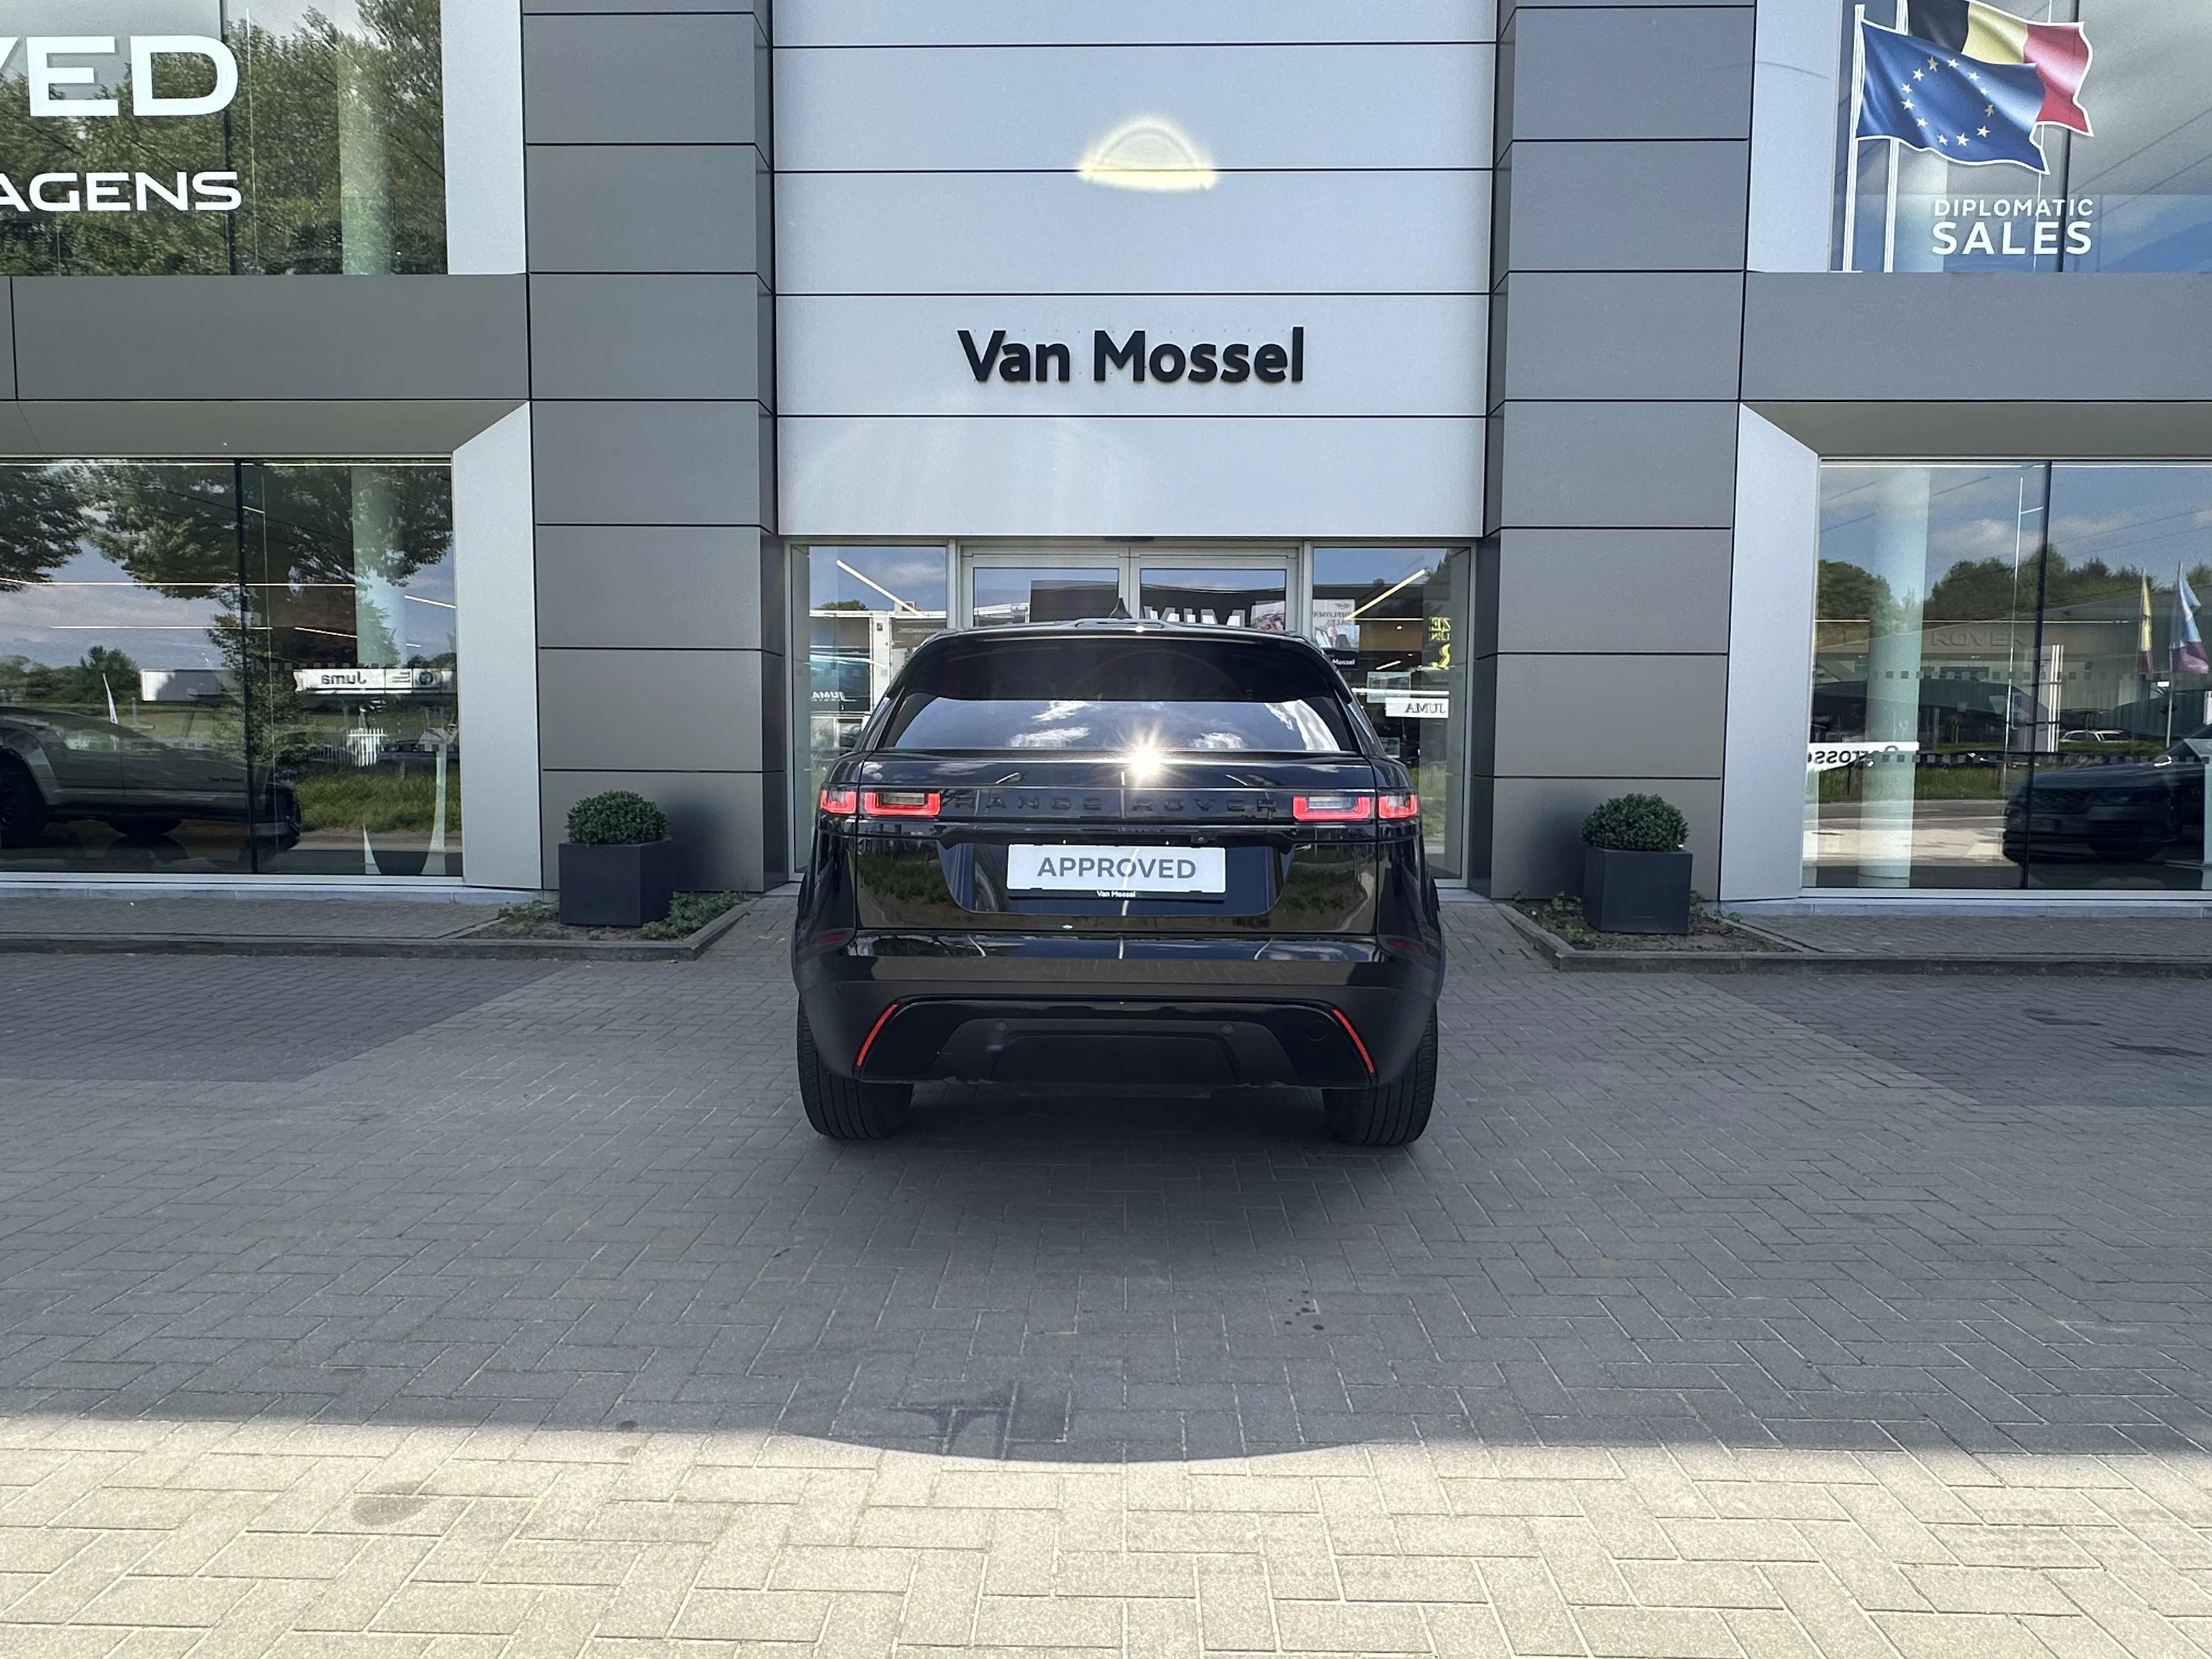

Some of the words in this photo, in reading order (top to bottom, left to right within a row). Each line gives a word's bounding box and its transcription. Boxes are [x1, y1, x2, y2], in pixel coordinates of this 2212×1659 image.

[1933, 198, 2094, 217] DIPLOMATIC
[1932, 221, 2093, 256] SALES
[957, 329, 1070, 382] Van
[1093, 326, 1304, 382] Mossel
[955, 795, 1102, 810] RANGE
[1132, 798, 1278, 813] ROVER
[1037, 856, 1197, 880] APPROVED
